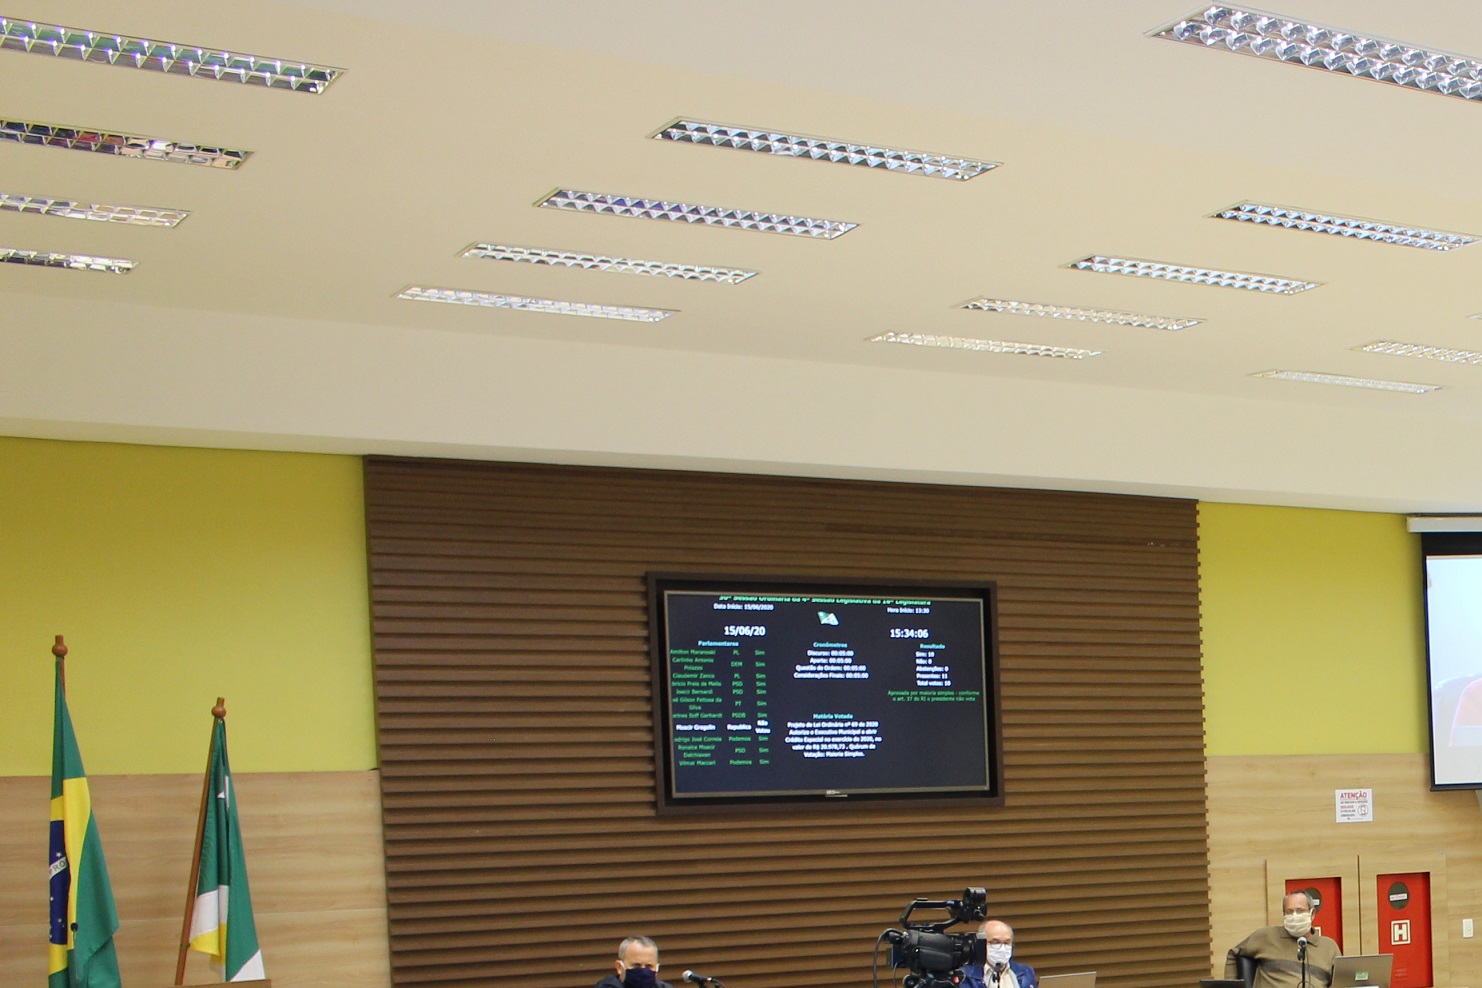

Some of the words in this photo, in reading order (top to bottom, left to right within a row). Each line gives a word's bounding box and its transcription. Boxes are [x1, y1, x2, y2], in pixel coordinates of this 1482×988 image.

[724, 625, 766, 637] 15/06/20
[890, 628, 929, 639] 15:34:06
[1340, 790, 1367, 800] ATENÇÃO
[1394, 924, 1408, 941] H
